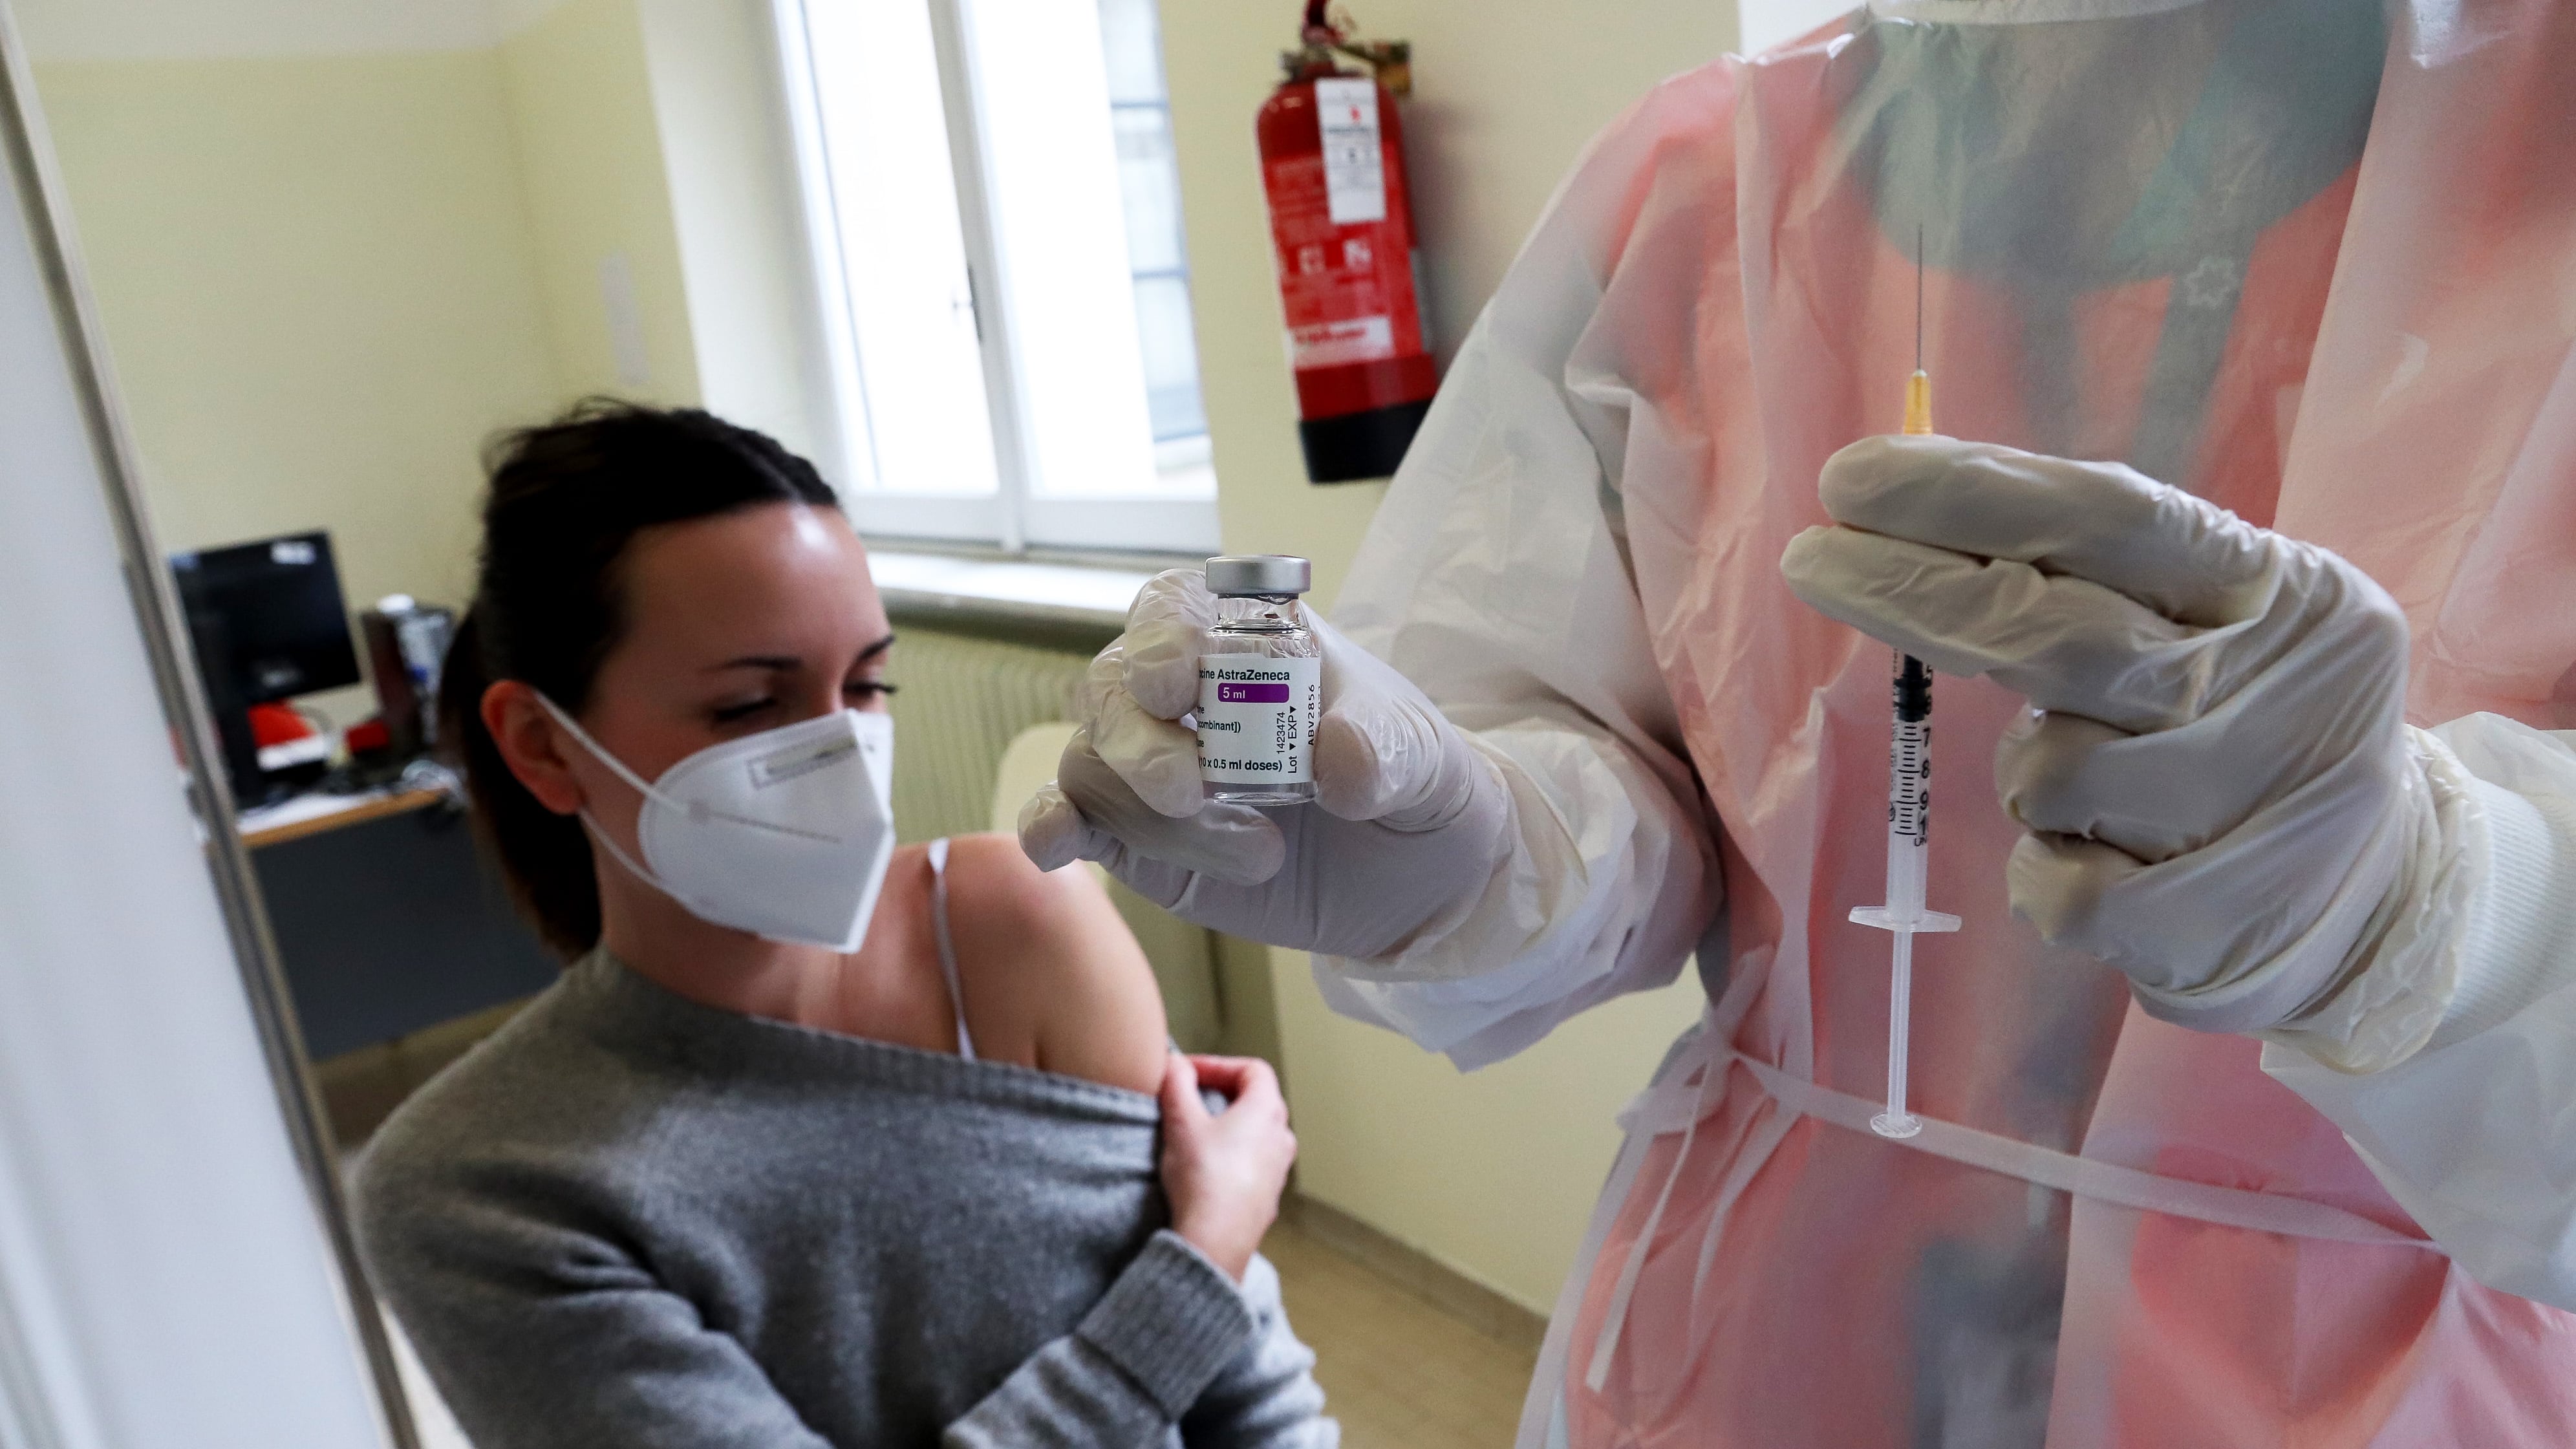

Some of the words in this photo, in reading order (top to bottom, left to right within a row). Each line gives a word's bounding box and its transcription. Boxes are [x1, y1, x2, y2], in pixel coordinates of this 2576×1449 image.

[1218, 669, 1290, 680] AstraZeneca
[1223, 687, 1230, 698] 5
[1233, 690, 1245, 699] ml
[1276, 712, 1285, 754] 1423474
[1213, 758, 1227, 769] 0.5
[1229, 760, 1241, 769] ml
[1245, 760, 1282, 772] doses)
[1288, 755, 1297, 773] Lot
